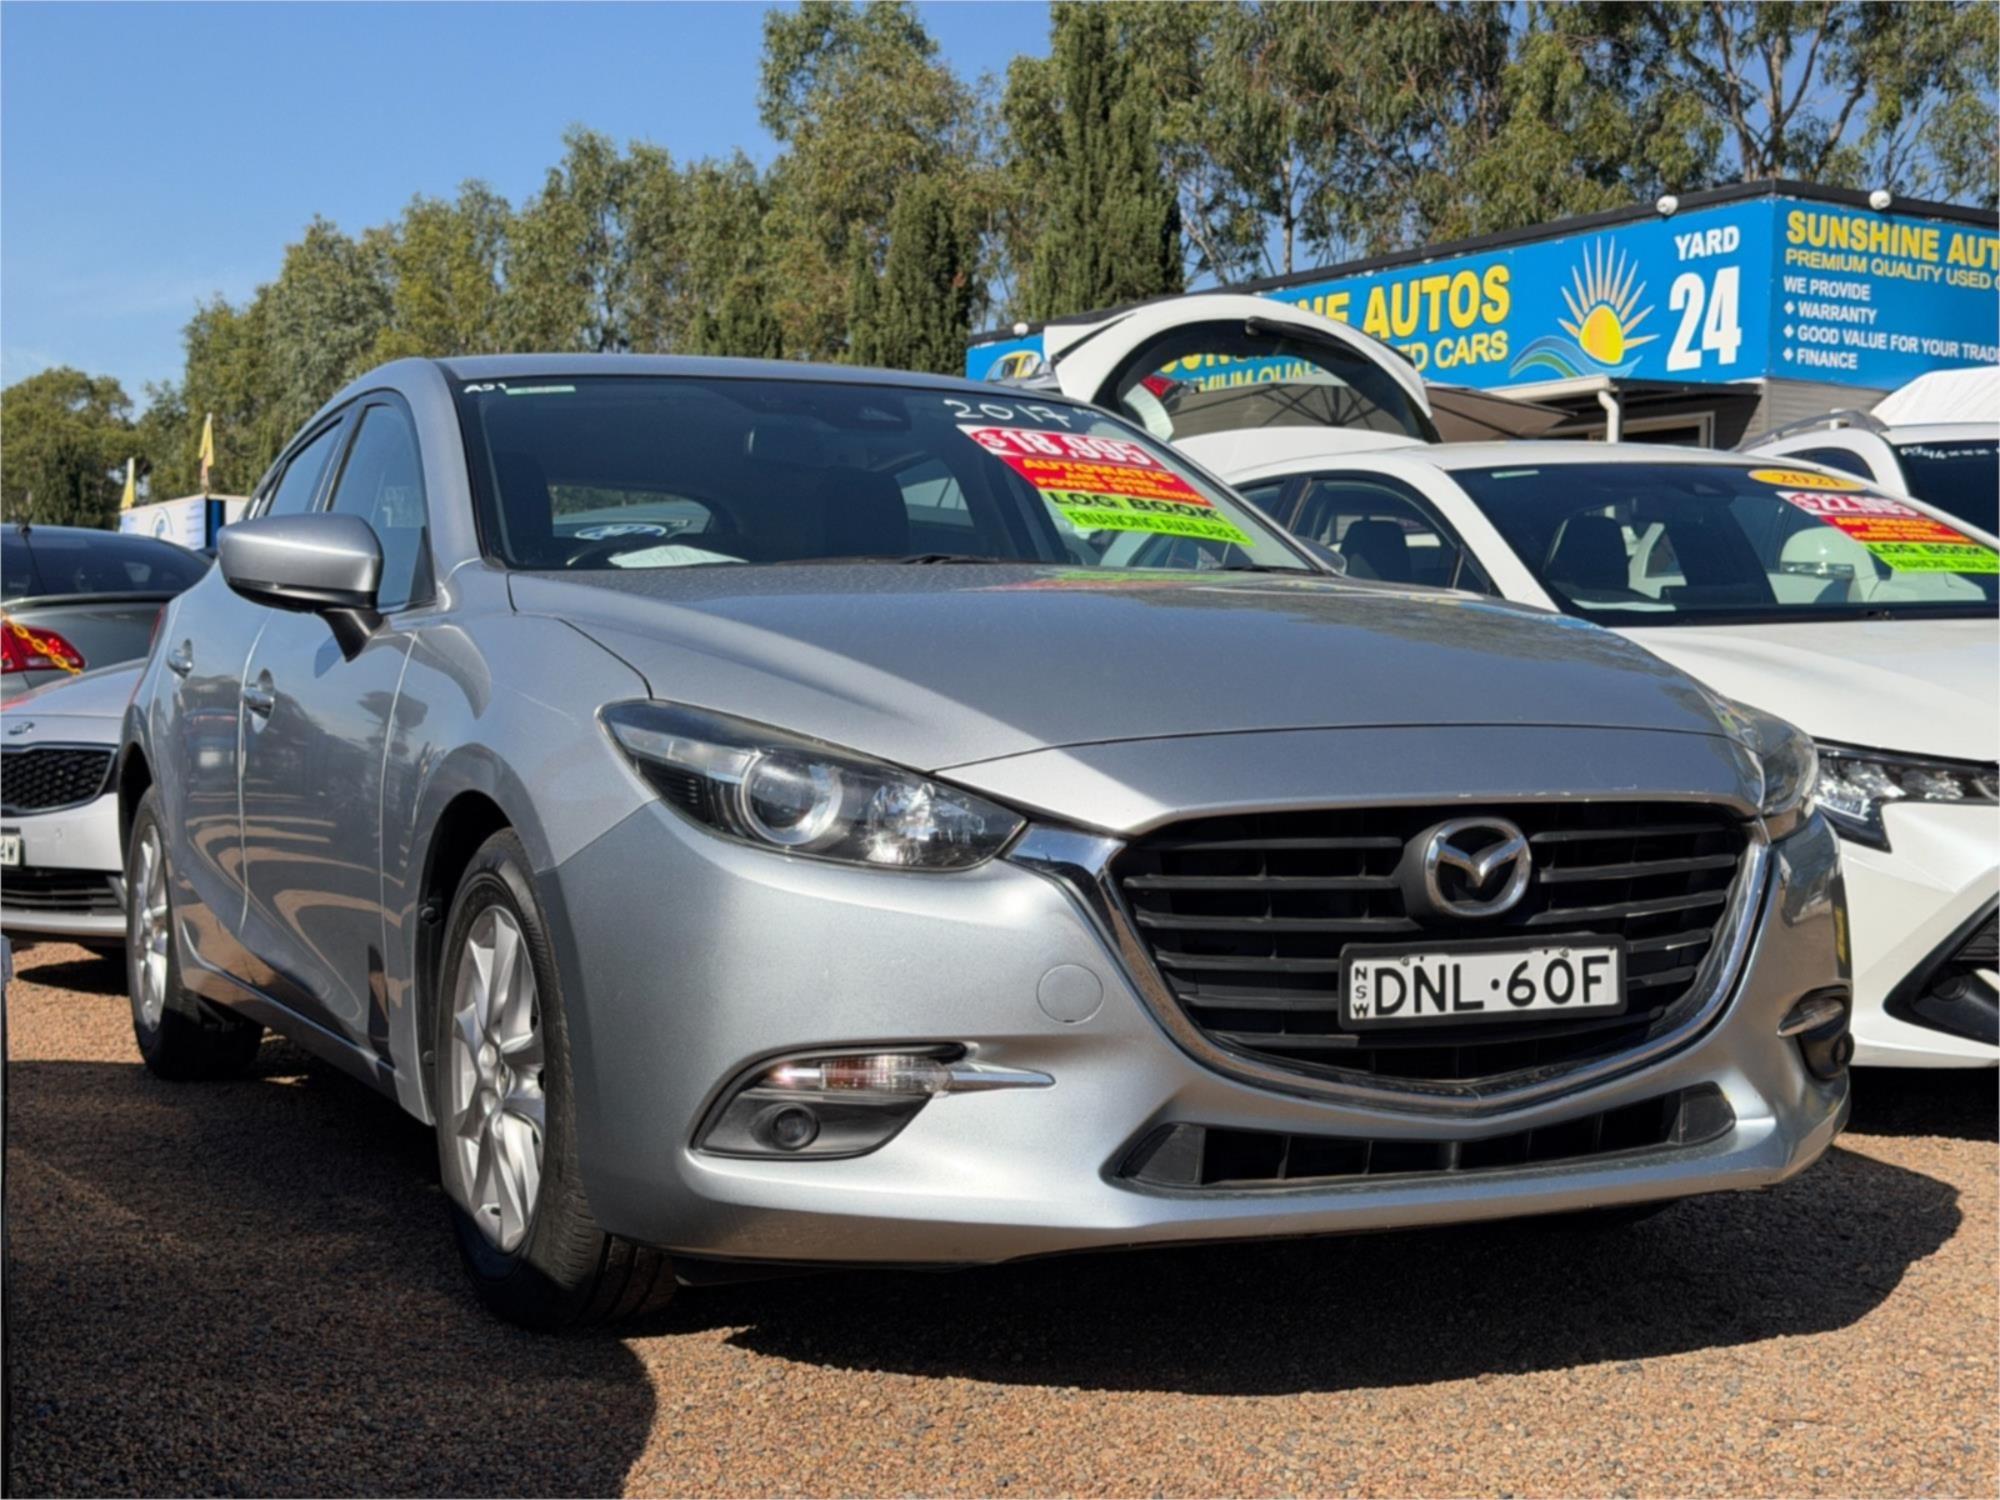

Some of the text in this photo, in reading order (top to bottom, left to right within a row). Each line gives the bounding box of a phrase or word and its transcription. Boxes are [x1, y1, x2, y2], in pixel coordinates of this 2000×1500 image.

[1675, 226, 1740, 261] YARD
[1786, 209, 1940, 262] SUNSHINE
[1785, 248, 1867, 274] PREMIUM
[1871, 258, 1943, 283] QUALITY
[1946, 268, 1991, 289] USED
[1362, 264, 1511, 340] AUTOS
[1784, 276, 1871, 300] WE PROVIDE
[1666, 266, 1742, 372] 24
[1798, 302, 1878, 325] WARRANTY
[1434, 330, 1508, 369] CARS
[1797, 324, 1840, 345] GOOD
[1843, 330, 1887, 350] VALUE
[1890, 335, 1918, 353] FOR
[1921, 338, 1959, 358] YOUR
[1797, 348, 1858, 370] FINANCE
[943, 399, 1072, 428] 2017
[977, 430, 1152, 466] $18,995
[1022, 457, 1176, 484] AUTOMATIC
[1048, 490, 1226, 522] LOG BOOK
